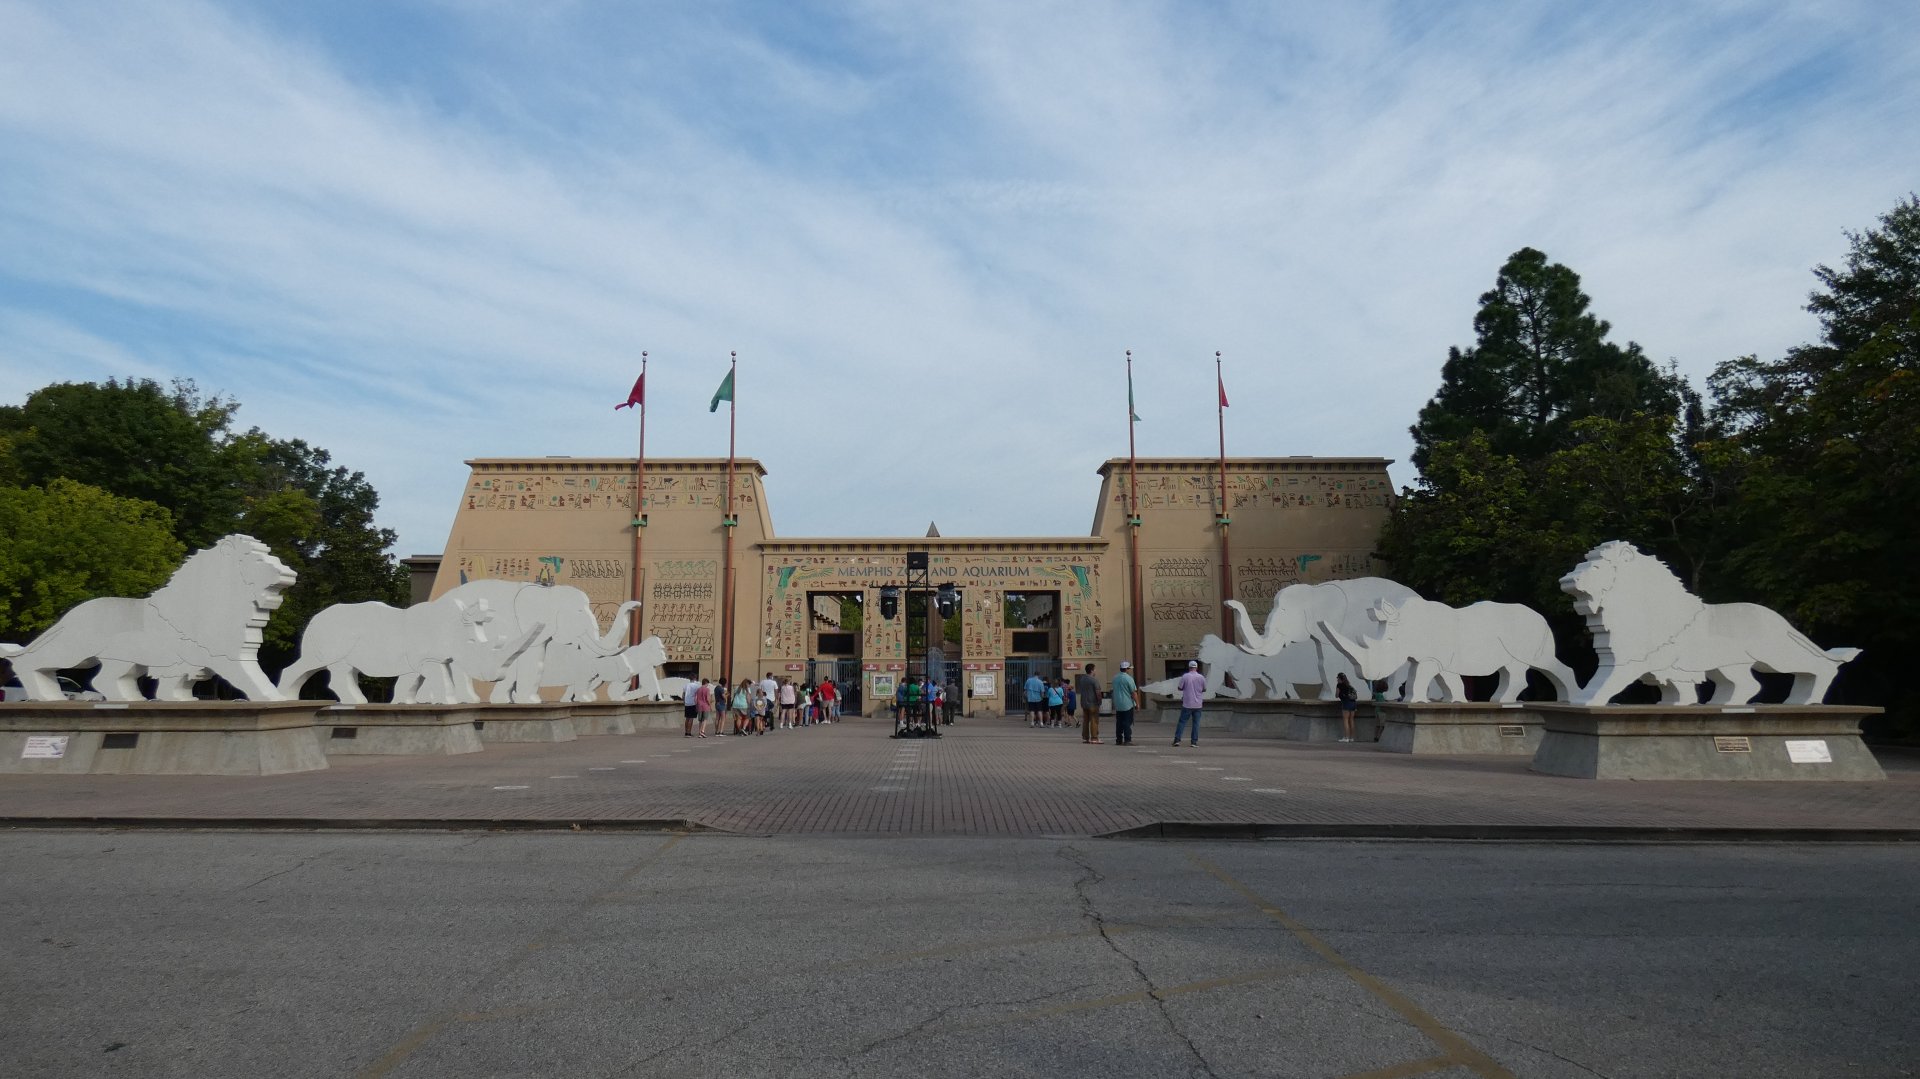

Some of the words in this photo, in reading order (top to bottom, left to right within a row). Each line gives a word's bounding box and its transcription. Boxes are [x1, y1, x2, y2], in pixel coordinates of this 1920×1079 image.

[837, 567, 893, 577] MEMPHIS
[931, 567, 958, 577] AND
[962, 566, 1030, 578] AQUARIUM
